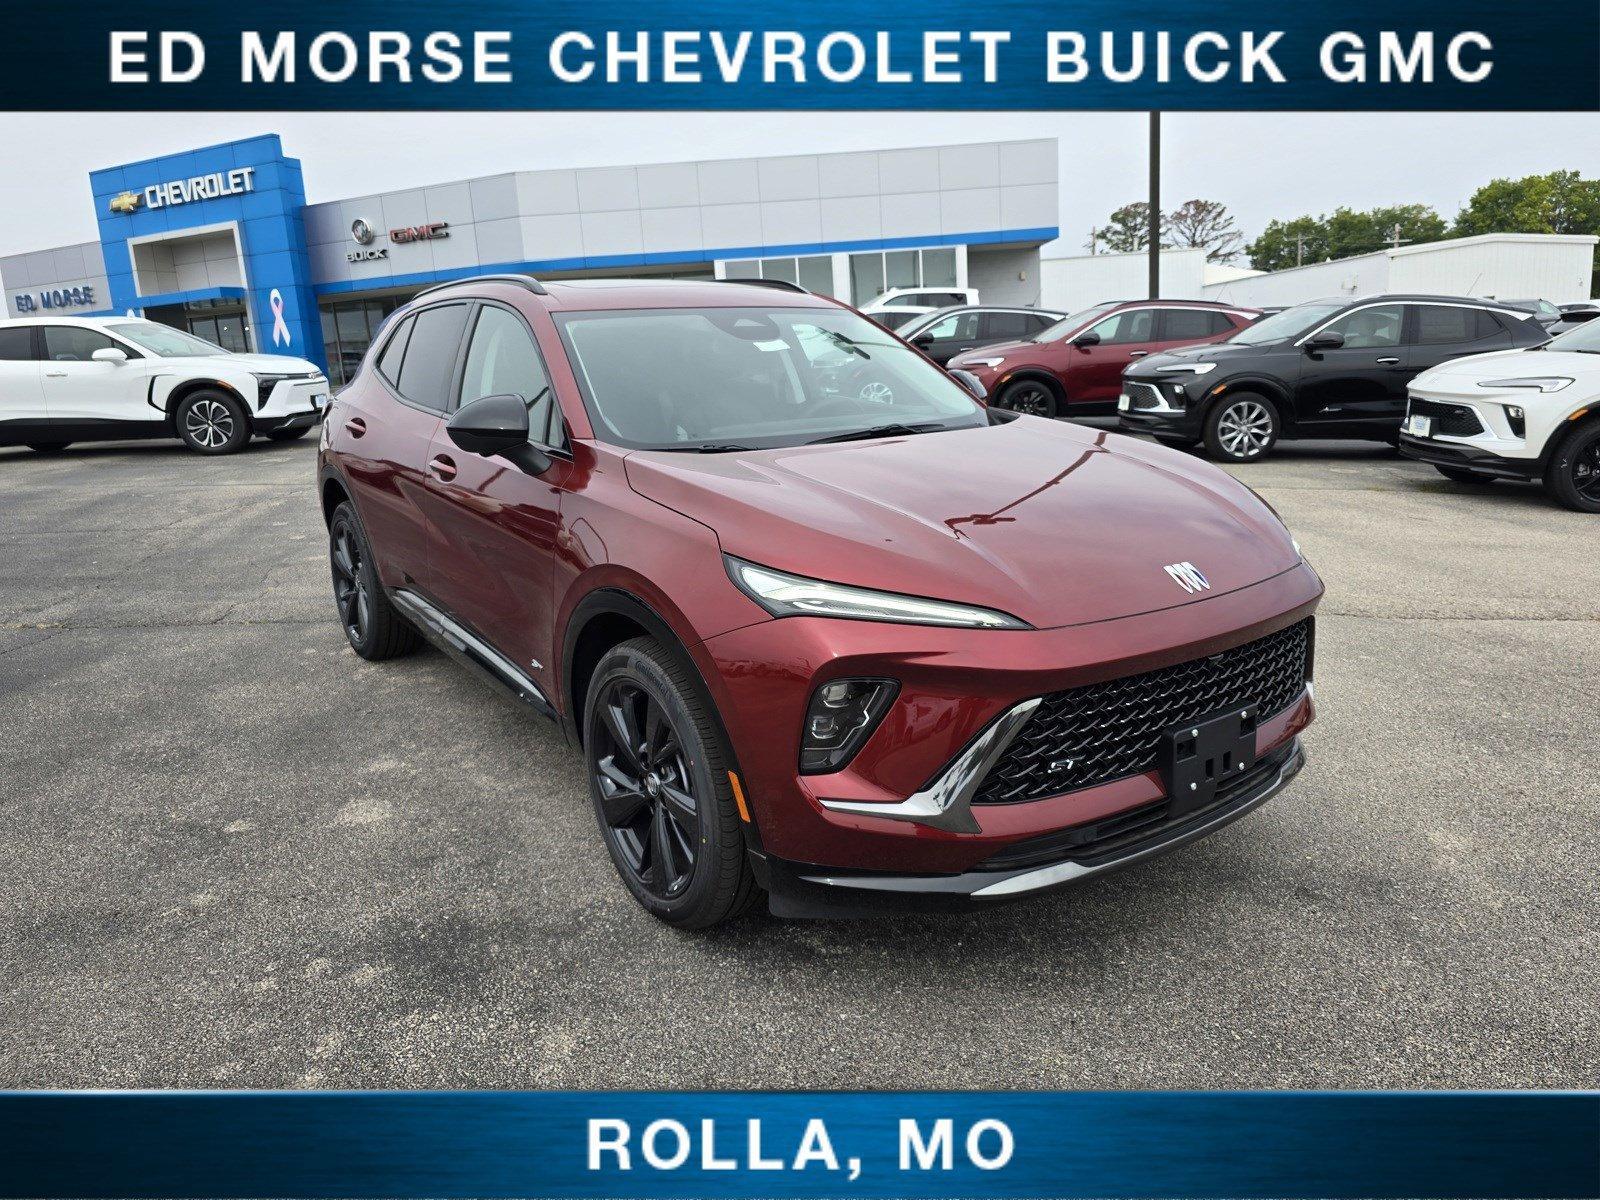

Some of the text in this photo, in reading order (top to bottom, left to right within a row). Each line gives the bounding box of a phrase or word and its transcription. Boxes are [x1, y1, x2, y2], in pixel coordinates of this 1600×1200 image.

[144, 166, 255, 209] CHEVROLET
[390, 222, 450, 245] GMC
[346, 249, 389, 262] BUICK
[15, 285, 95, 313] ED MORSE
